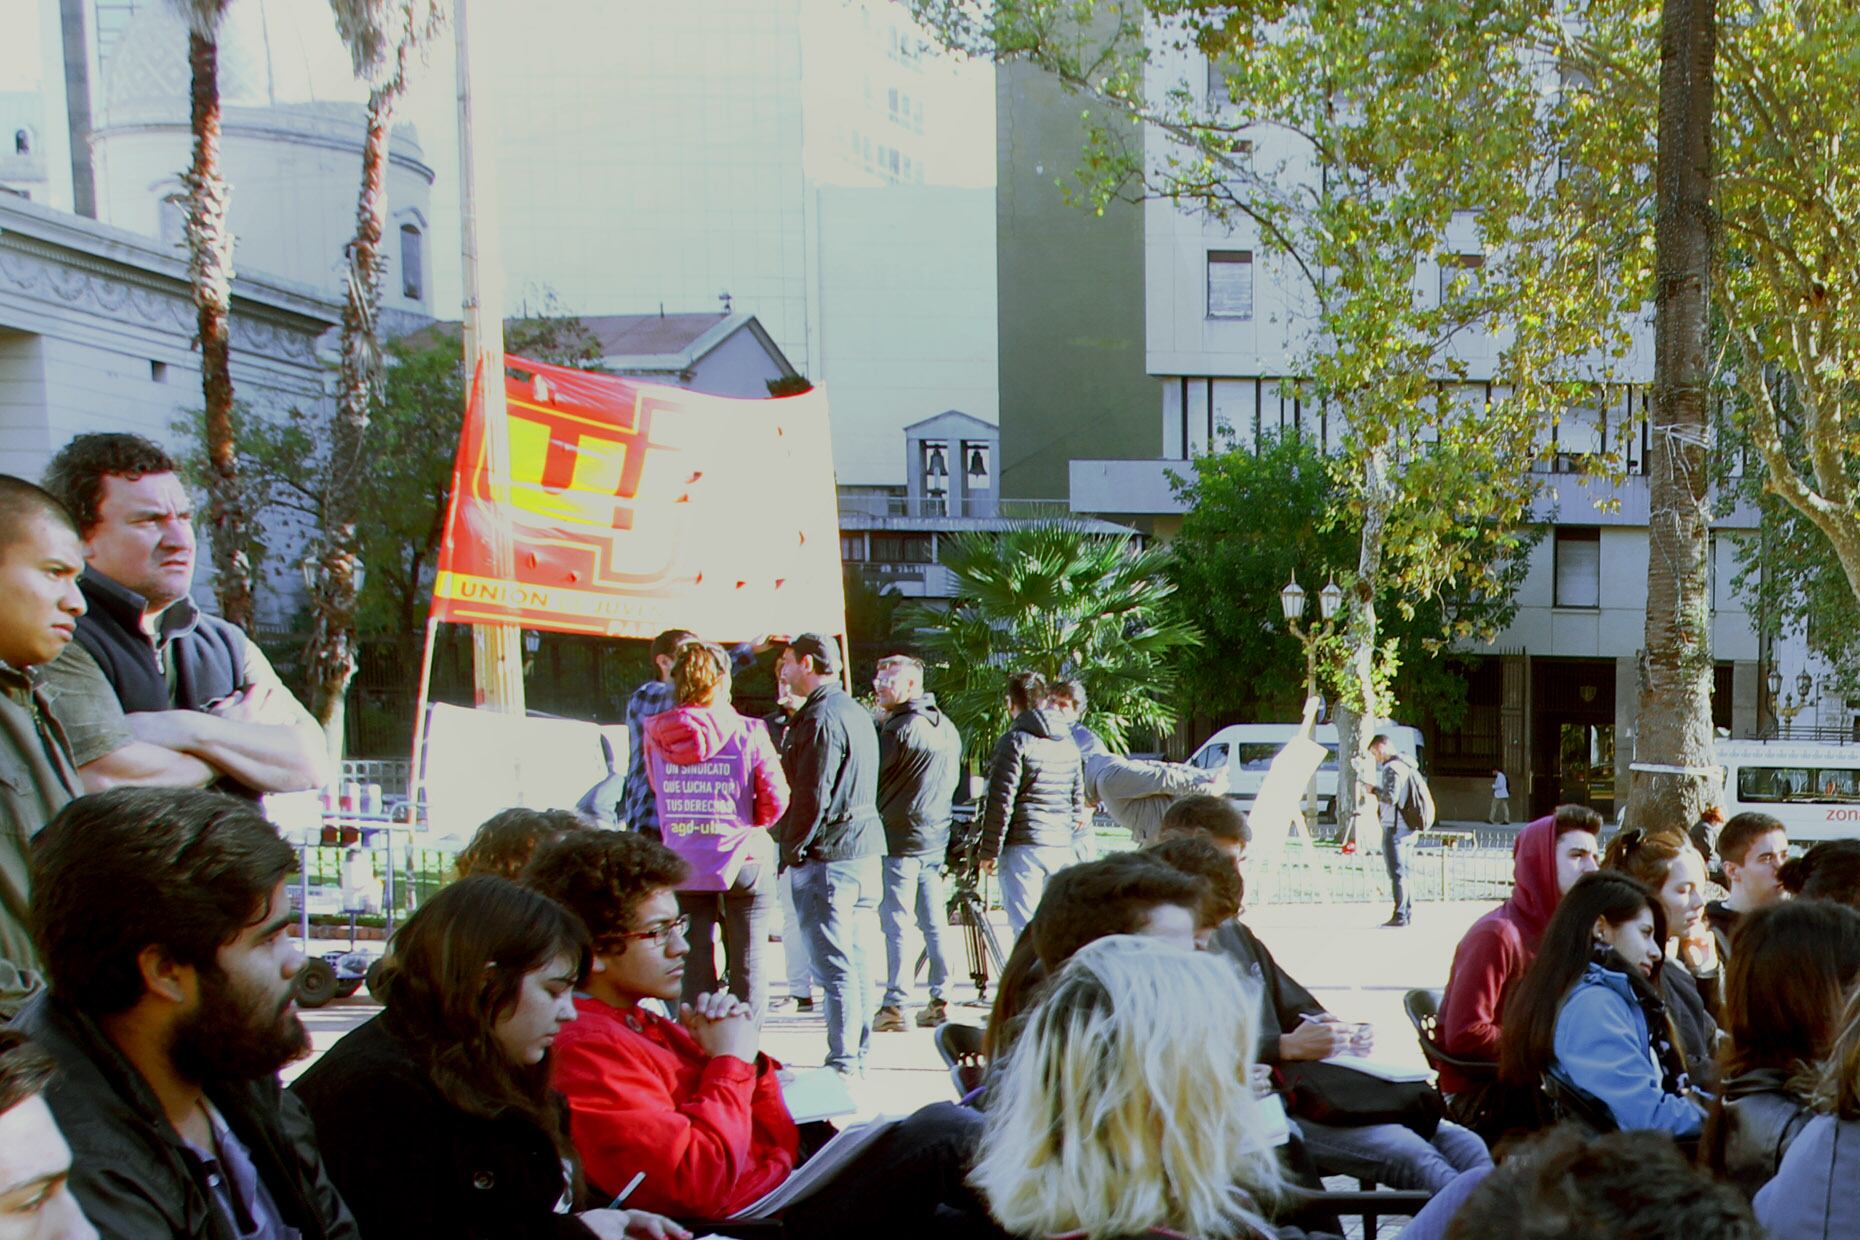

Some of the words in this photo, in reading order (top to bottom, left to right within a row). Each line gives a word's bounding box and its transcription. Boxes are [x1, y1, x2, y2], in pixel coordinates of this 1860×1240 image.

[681, 763, 730, 775] SINDICATO
[663, 780, 681, 793] QUE
[682, 781, 712, 794] LUCHA
[715, 781, 735, 794] POR
[665, 799, 682, 811] TUS
